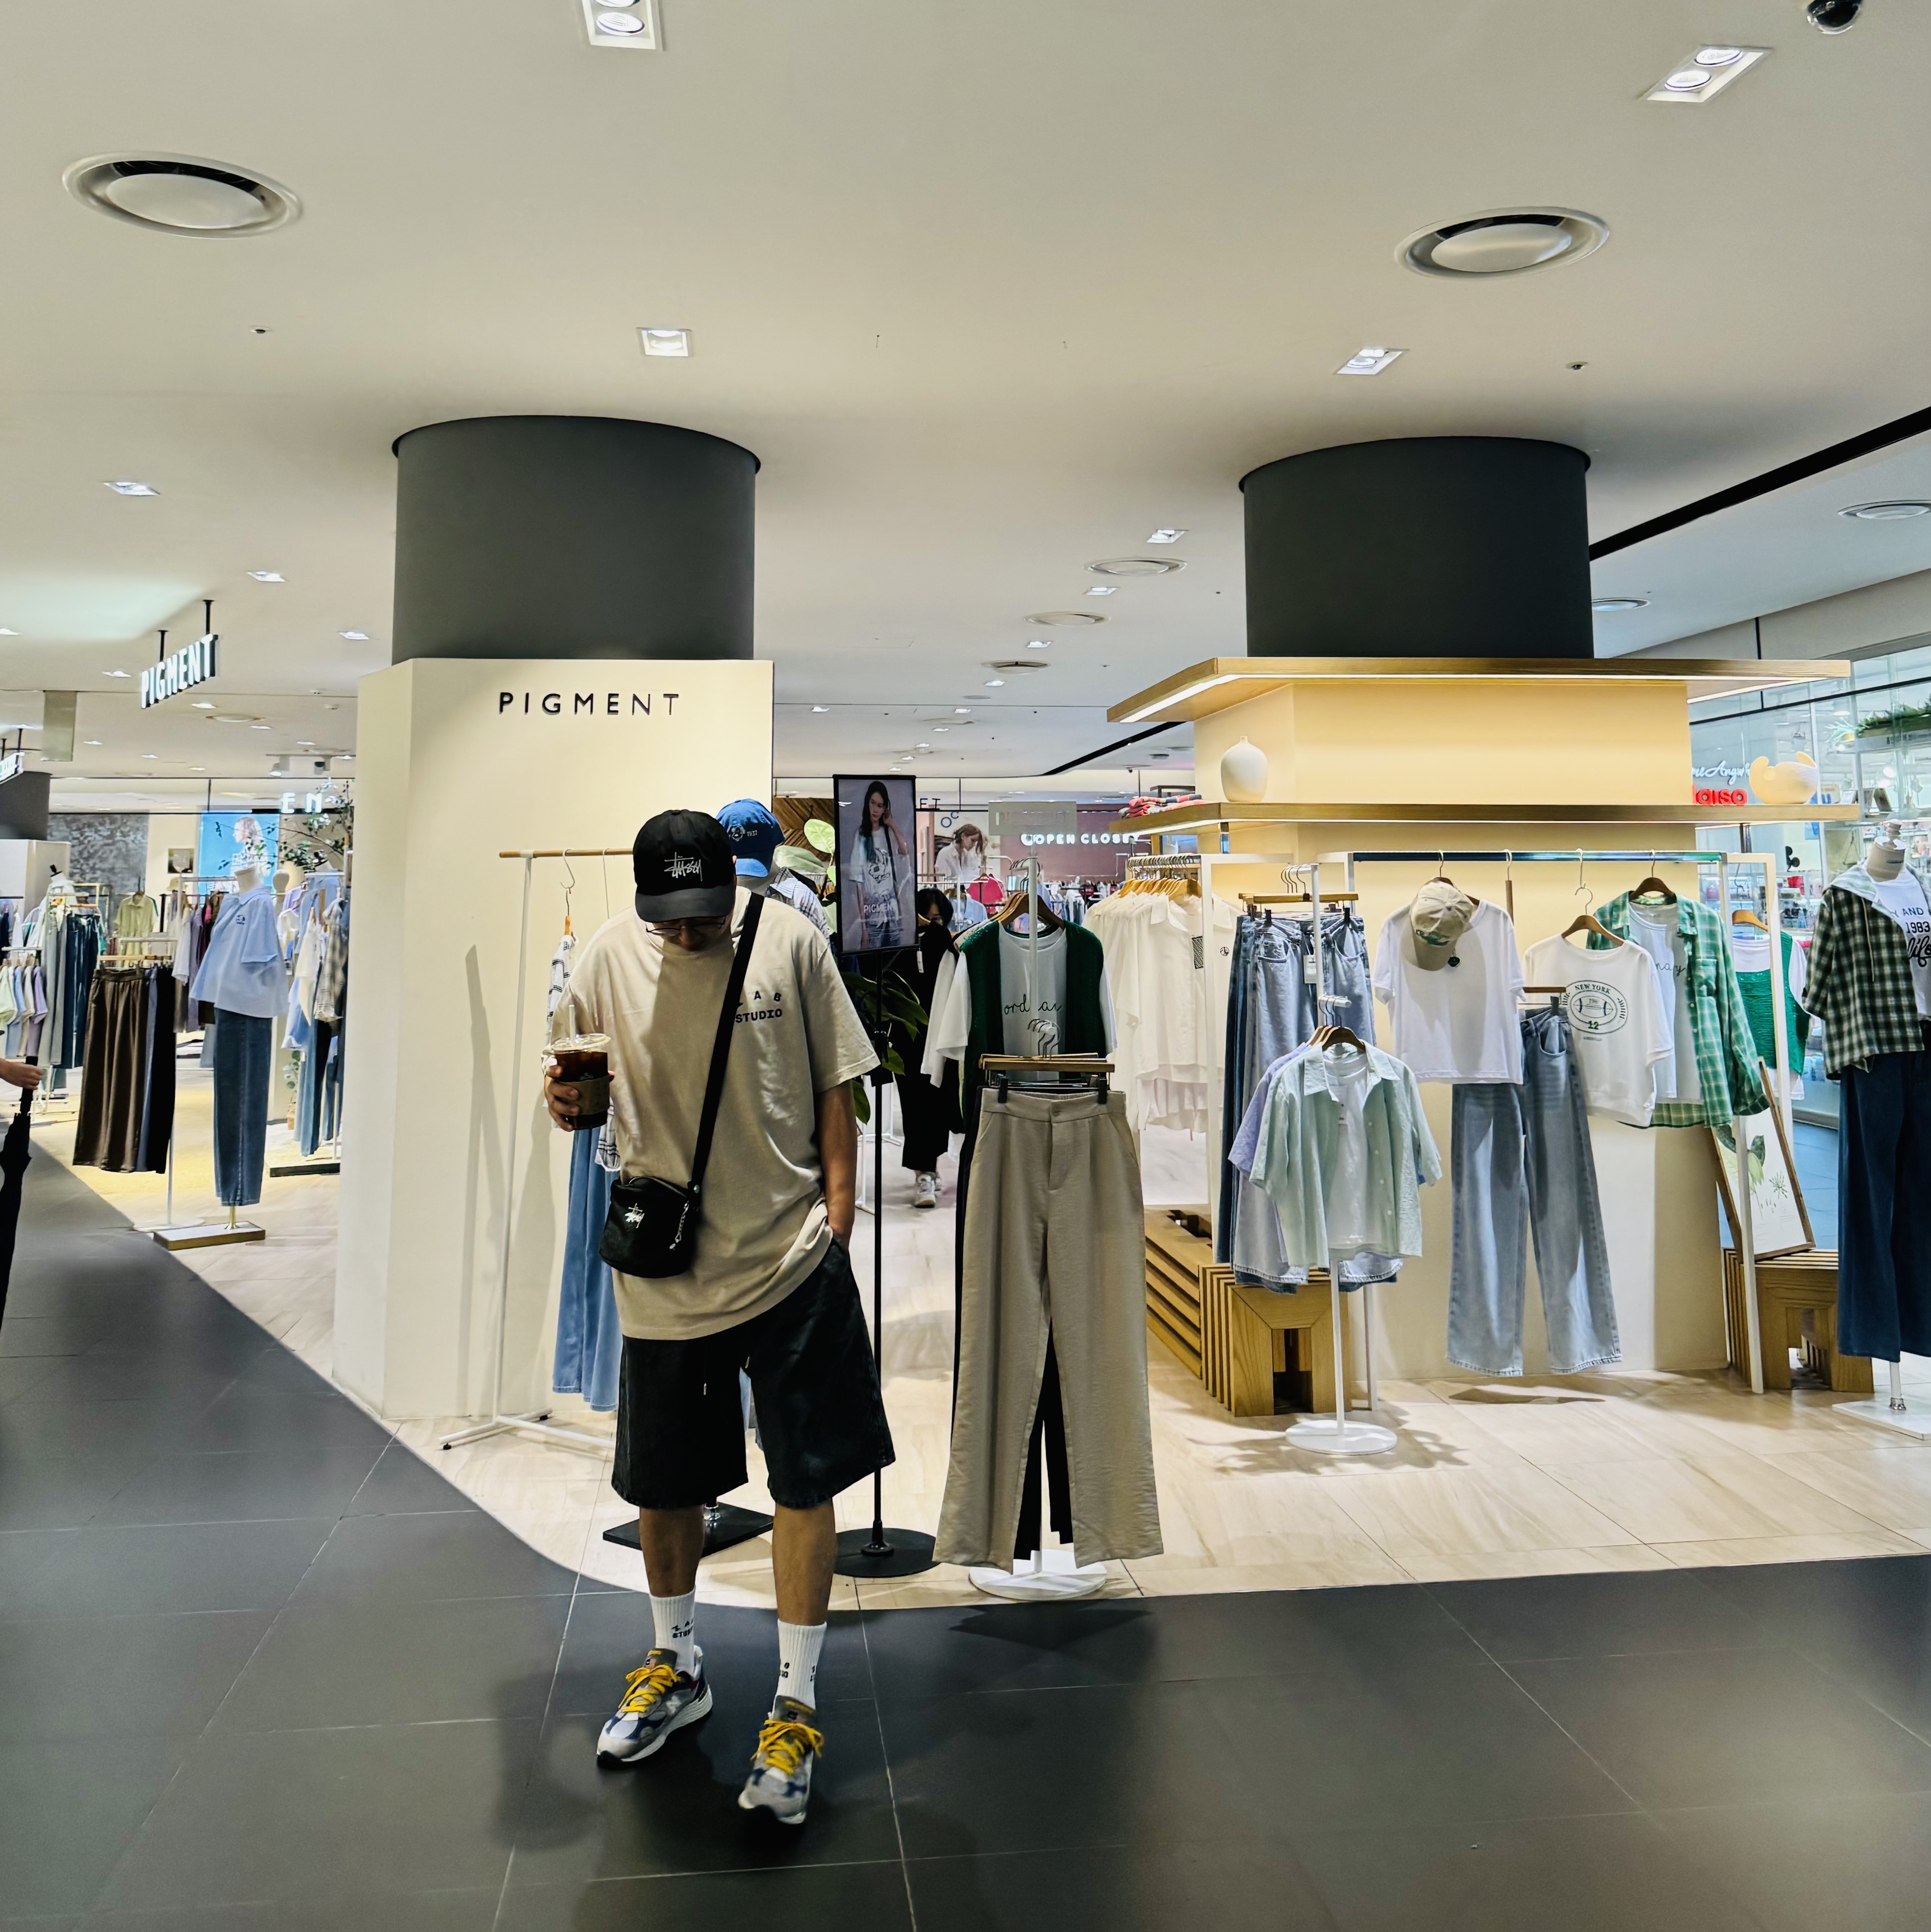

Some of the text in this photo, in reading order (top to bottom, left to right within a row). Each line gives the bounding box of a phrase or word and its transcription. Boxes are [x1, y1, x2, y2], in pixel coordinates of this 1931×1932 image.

[141, 633, 214, 709] PIGMENT
[499, 692, 679, 715] PIGMENT
[1902, 907, 1924, 916] AND
[1906, 921, 1931, 933] 1983
[1592, 984, 1611, 994] YORK
[735, 1008, 783, 1023] STUDIO
[1588, 1020, 1599, 1030] 12
